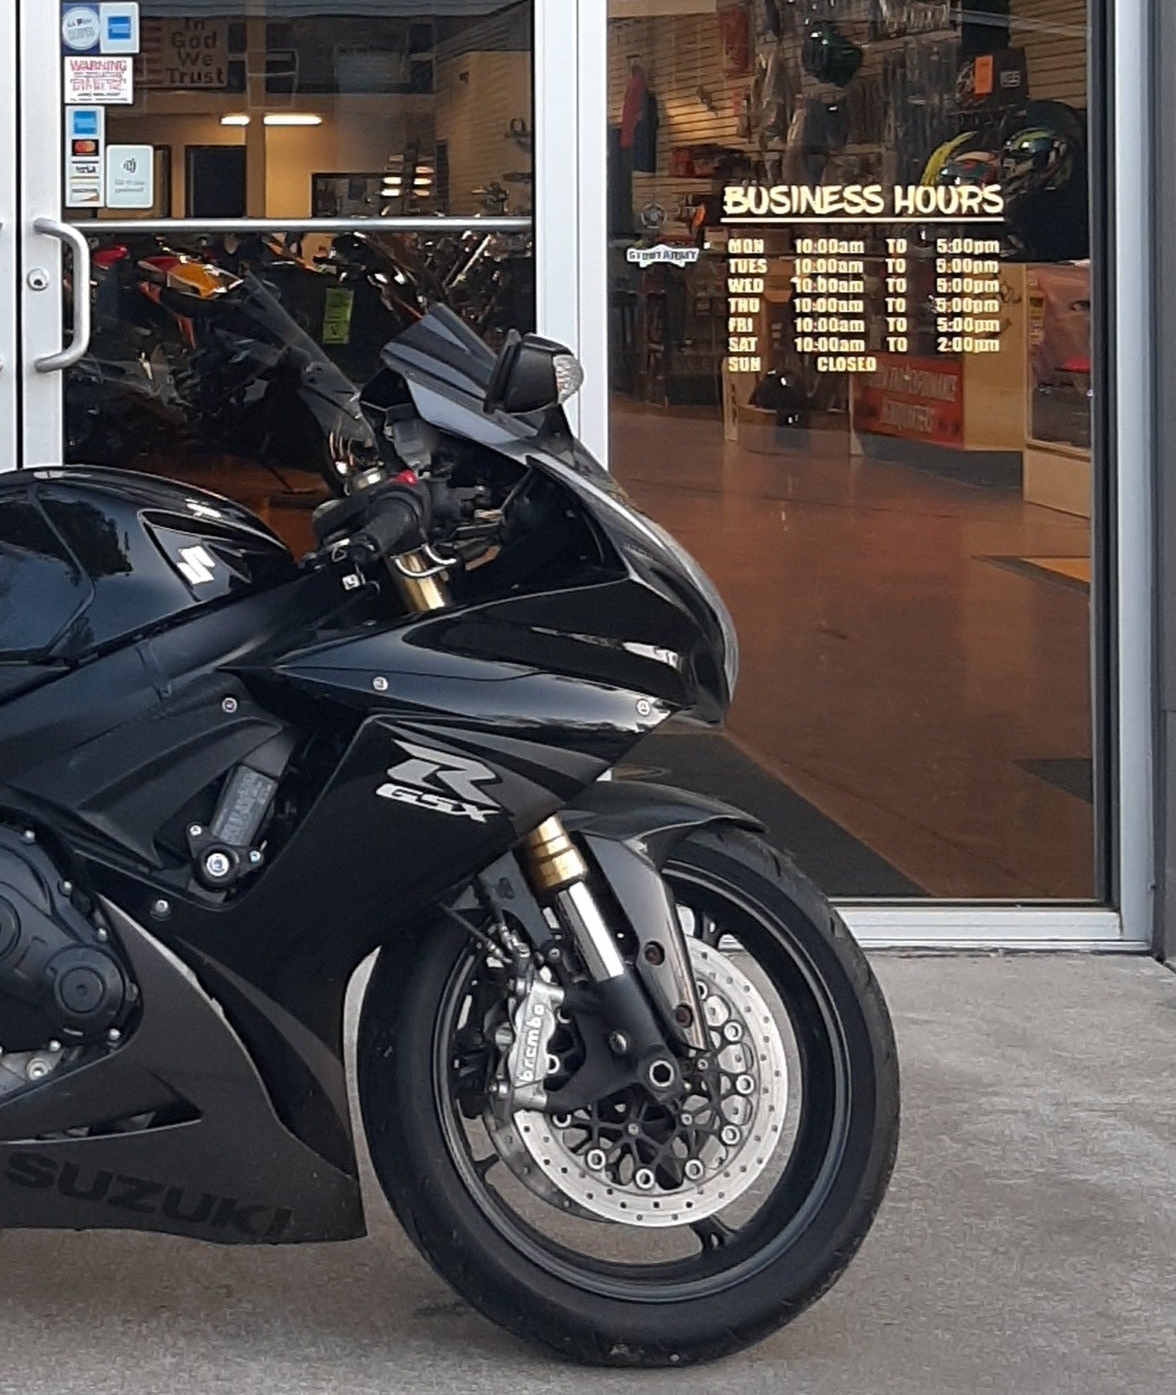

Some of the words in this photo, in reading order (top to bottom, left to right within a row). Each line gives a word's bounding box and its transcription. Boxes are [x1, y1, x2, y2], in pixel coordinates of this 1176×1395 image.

[171, 30, 217, 49] God
[177, 49, 213, 67] We
[165, 67, 225, 84] Trust
[723, 184, 885, 215] BUSINESS
[894, 183, 1005, 215] HOURS
[727, 238, 764, 254] MON
[794, 238, 865, 254] 10:00am
[886, 238, 907, 254] TO
[936, 238, 1000, 255] 5:00pm
[727, 258, 767, 274] TUES
[794, 258, 865, 274] 10:00am
[886, 258, 907, 274] TO
[936, 258, 1000, 275] 5:00pm
[727, 278, 764, 293] WED
[794, 278, 865, 293] 10:00am
[886, 278, 907, 293] TO
[936, 278, 1000, 294] 5:00pm
[727, 298, 760, 313] THU
[794, 298, 865, 313] 10:00am
[886, 298, 907, 313] TO
[936, 298, 1000, 314] 5:00pm
[727, 317, 753, 333] FRI
[794, 317, 865, 333] 10:00am
[886, 317, 907, 333] TO
[936, 317, 1000, 334] 5:00pm
[727, 337, 758, 352] SAT
[794, 337, 865, 352] 10:00am
[886, 337, 907, 352] TO
[936, 337, 1000, 353] 2:00pm
[727, 357, 761, 372] SUN
[817, 357, 877, 372] CLOSED
[375, 782, 502, 824] GSX
[518, 1003, 546, 1083] brembo
[3, 1149, 294, 1241] SUZUKI
